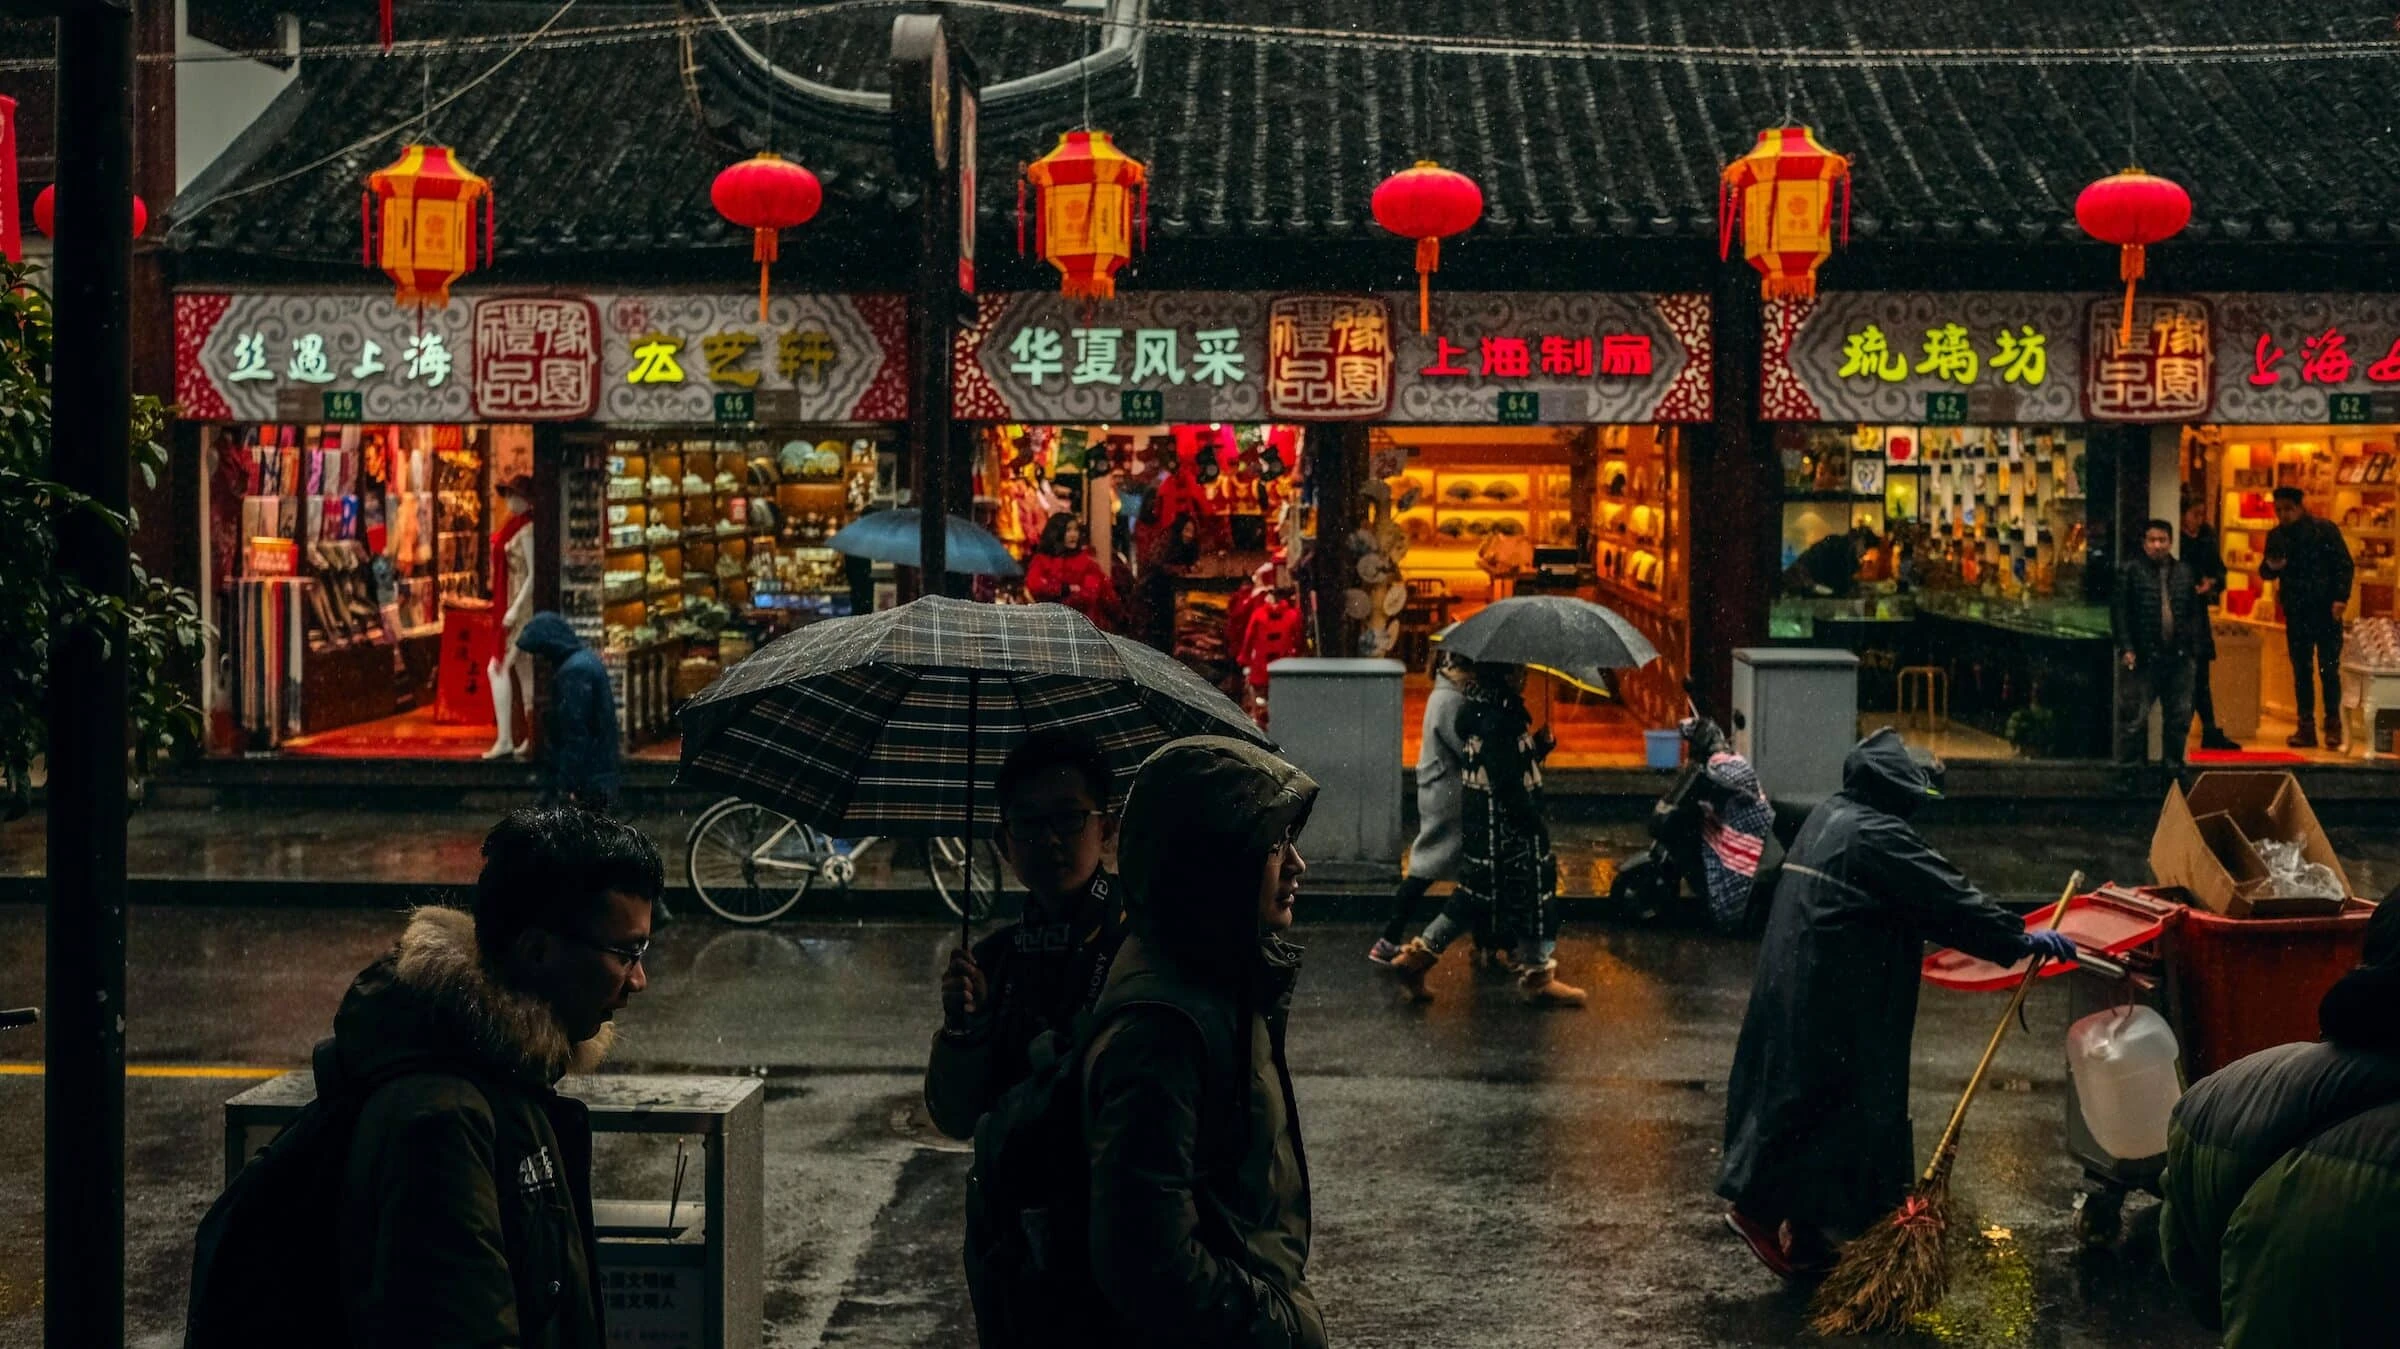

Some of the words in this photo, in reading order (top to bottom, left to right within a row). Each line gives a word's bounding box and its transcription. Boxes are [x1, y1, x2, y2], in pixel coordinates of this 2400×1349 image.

[228, 332, 453, 388] 丝遇上海
[1009, 326, 1246, 386] 华夏风采
[1838, 322, 2047, 385] 琉璃坊
[333, 393, 353, 411] 66
[724, 395, 745, 412] 66
[1132, 394, 1152, 411] 64
[1508, 394, 1528, 411] 64
[1936, 395, 1957, 412] 62
[2340, 397, 2360, 413] 62
